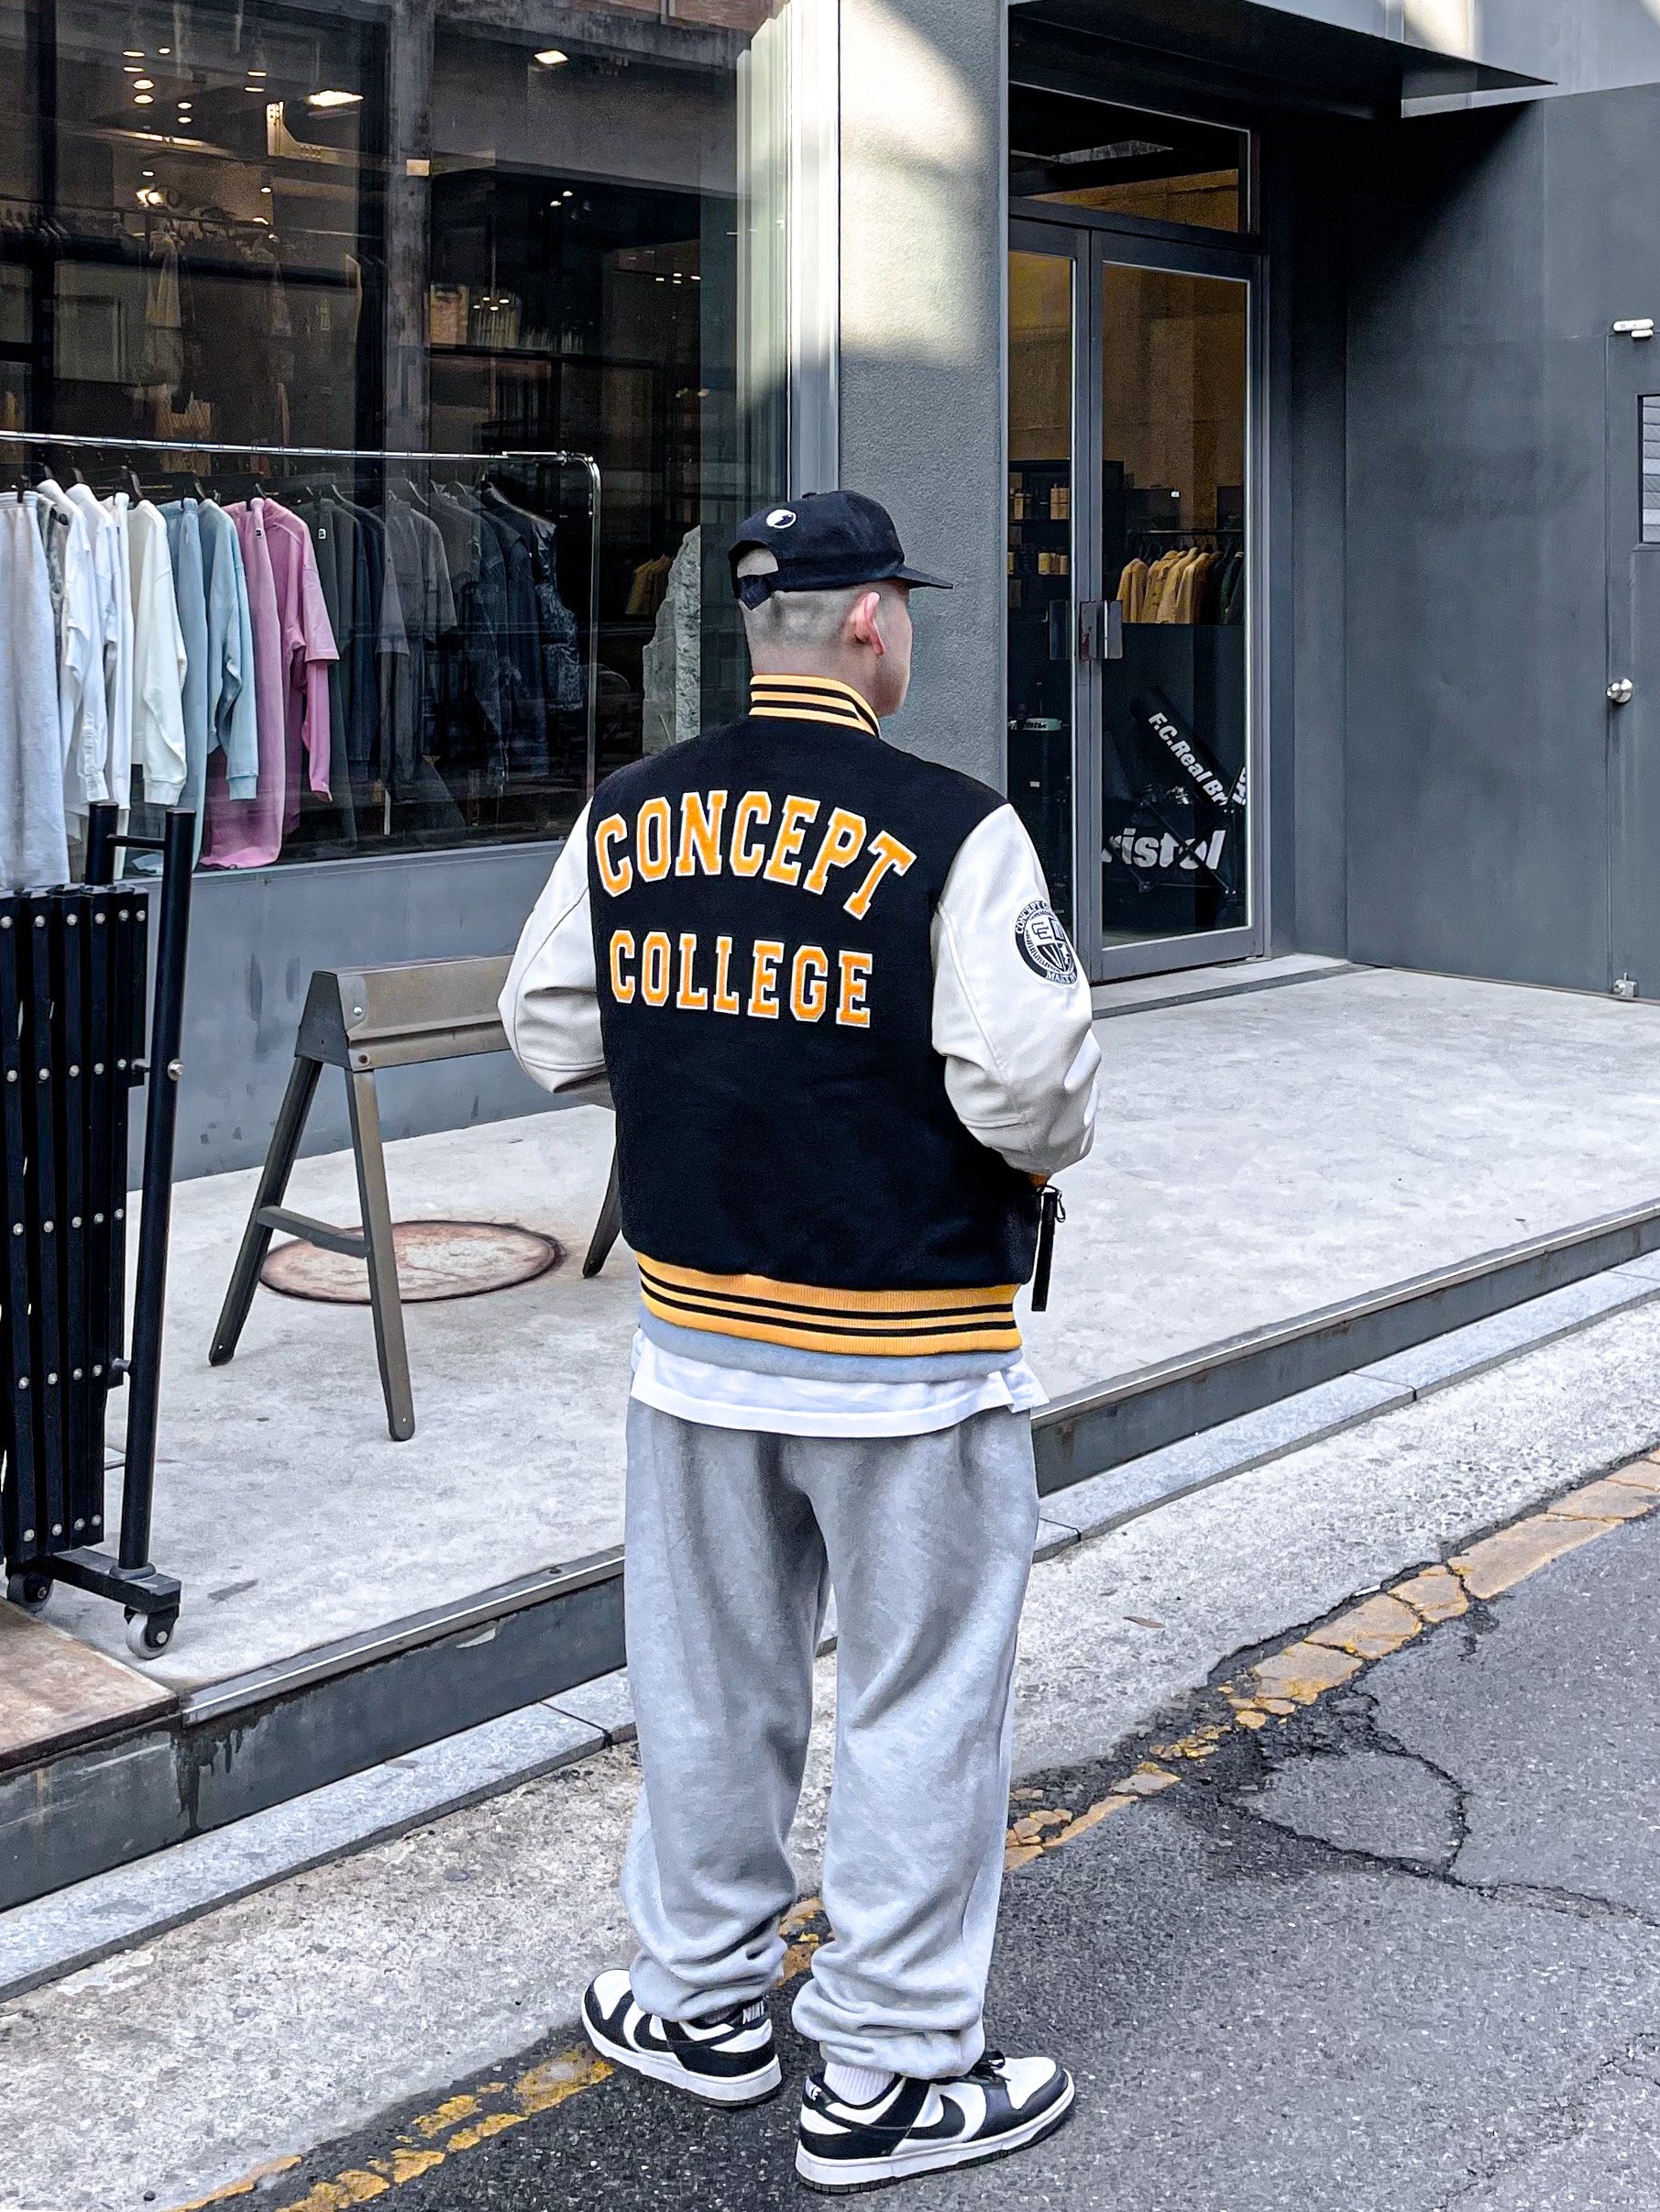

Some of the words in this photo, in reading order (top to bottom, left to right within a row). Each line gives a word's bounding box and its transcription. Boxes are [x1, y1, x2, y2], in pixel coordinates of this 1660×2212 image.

[595, 789, 918, 920] CONCEPT
[1015, 900, 1042, 934] CONCEPT
[610, 929, 873, 1029] COLLEGE
